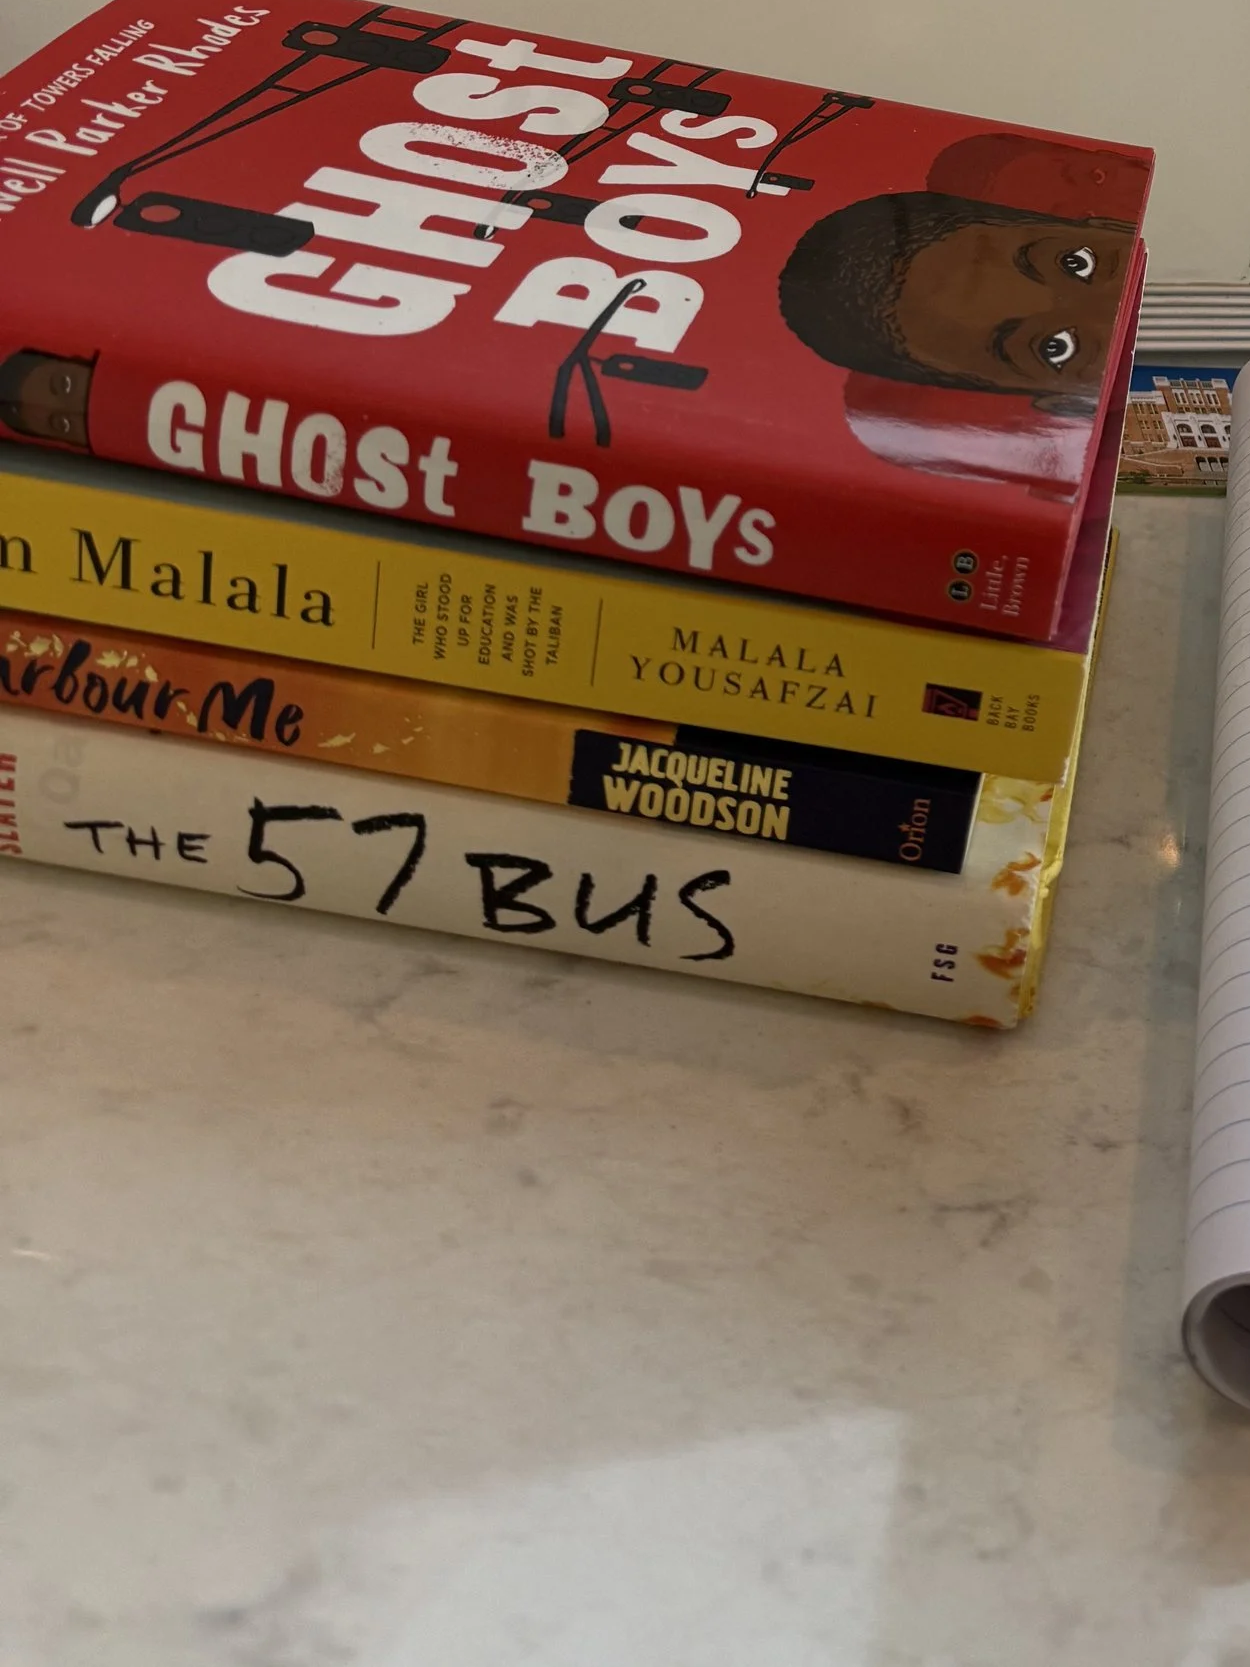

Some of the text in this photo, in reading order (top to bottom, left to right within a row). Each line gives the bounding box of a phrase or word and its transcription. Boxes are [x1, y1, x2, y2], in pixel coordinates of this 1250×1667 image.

[0, 18, 156, 132] OF TOWERS FALLING
[25, 79, 169, 157] Parker
[132, 5, 271, 77] Rhodes
[70, 526, 336, 628] Malala
[1002, 556, 1030, 617] Brown
[412, 581, 429, 645] THE GIRL
[433, 573, 453, 661] WHO STOOD
[457, 594, 473, 647] UP FOR
[478, 583, 497, 666] EDUCATION
[501, 594, 519, 663] AND WAS
[521, 586, 543, 678] SHOT BY THE
[545, 604, 564, 667] TALIBAN
[671, 625, 847, 680] MALALA
[196, 676, 305, 748] Me
[629, 653, 881, 720] YOUSAFZAI
[985, 694, 1004, 727] BACK
[1004, 706, 1021, 730] BAY
[1021, 693, 1041, 733] BOOKS
[610, 740, 793, 802] JACQUELINE
[601, 774, 792, 842] WOODSON
[900, 797, 932, 864] Orion
[63, 794, 736, 963] THE 57 BUS
